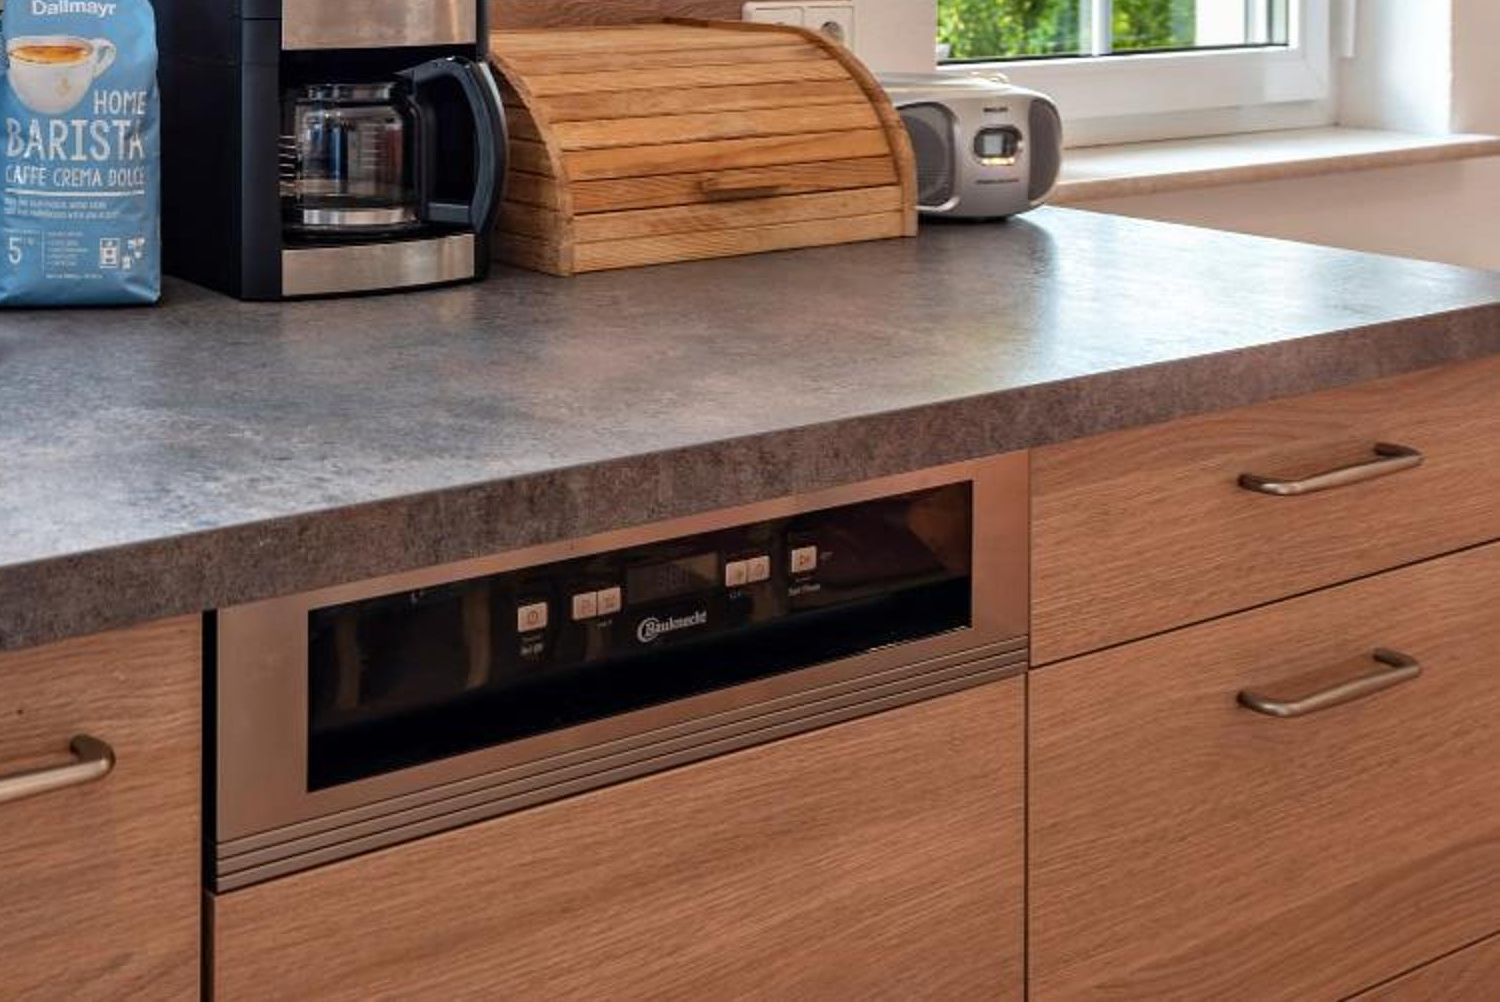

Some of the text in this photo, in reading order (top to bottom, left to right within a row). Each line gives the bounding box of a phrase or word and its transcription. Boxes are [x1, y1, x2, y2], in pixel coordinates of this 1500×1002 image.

[32, 0, 116, 18] Dallmayr
[93, 89, 147, 115] HOME
[5, 118, 145, 160] BARISTA
[53, 167, 102, 186] CREMA
[108, 166, 145, 186] DOLCE
[8, 237, 21, 264] 5
